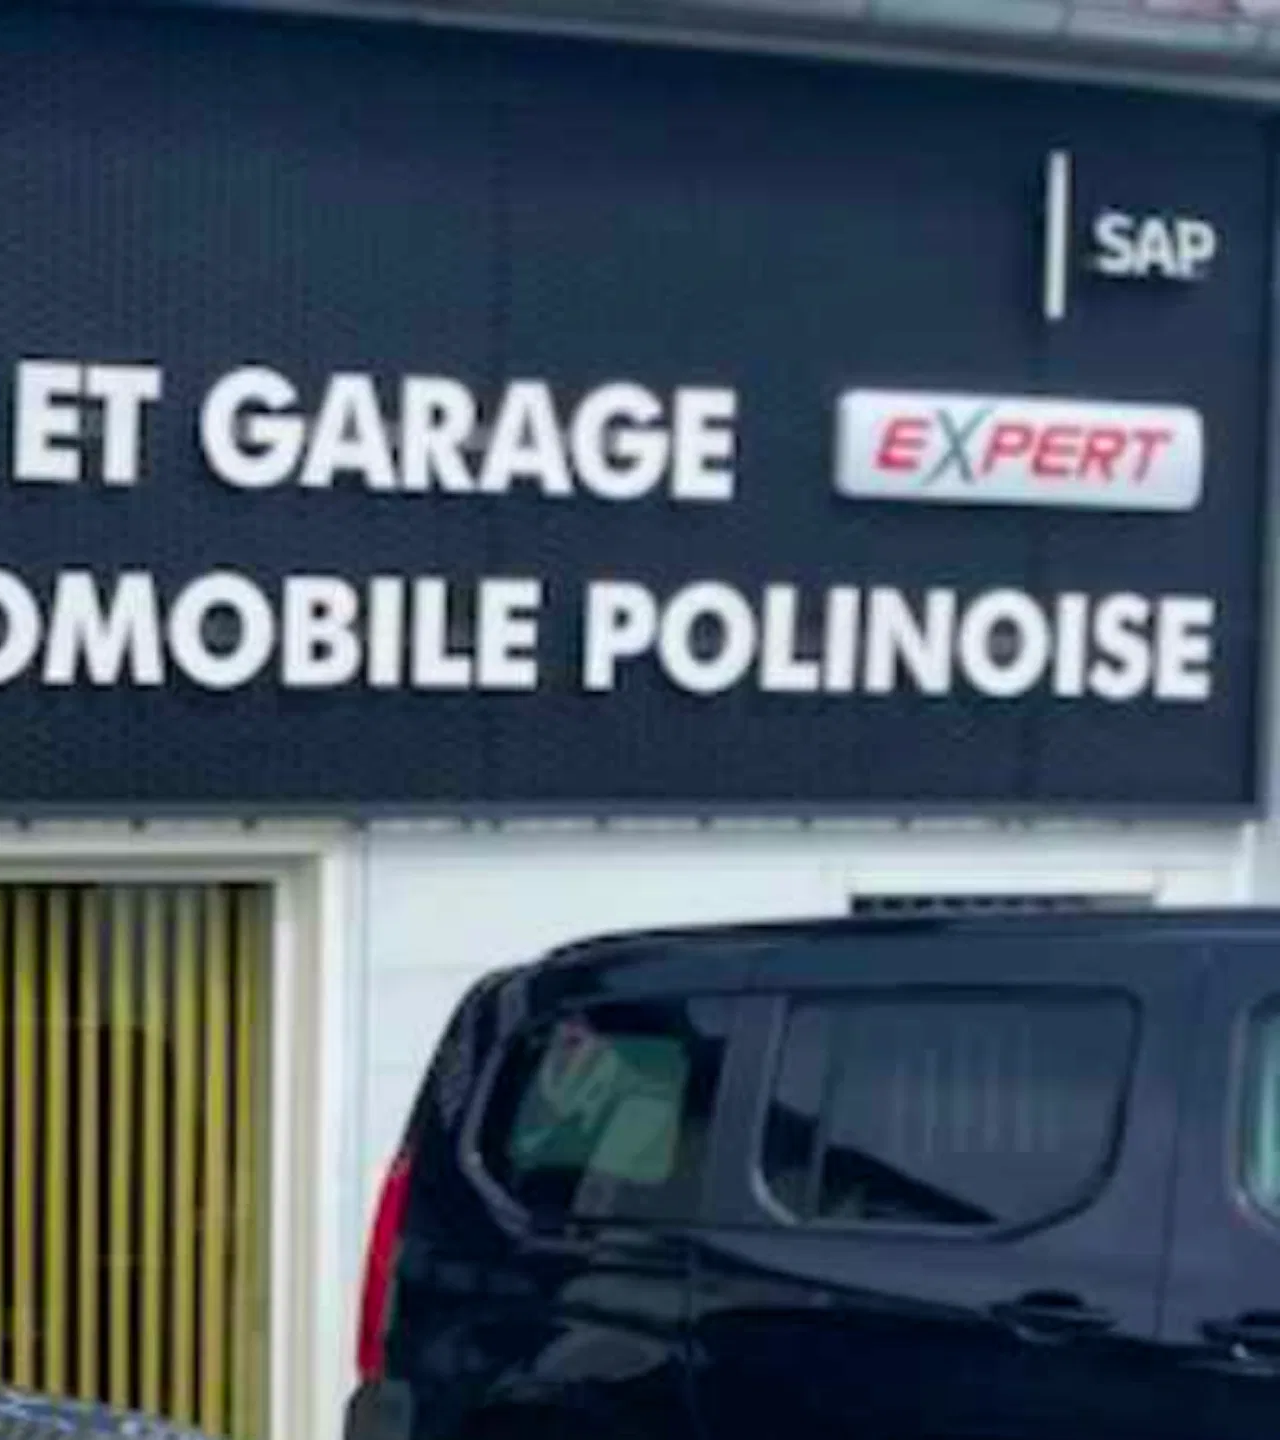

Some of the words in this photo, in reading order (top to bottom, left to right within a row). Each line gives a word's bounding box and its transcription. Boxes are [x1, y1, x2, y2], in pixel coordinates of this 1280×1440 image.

[1096, 213, 1216, 277] SAP
[14, 360, 162, 485] ET
[200, 366, 737, 501] GARAGE
[874, 408, 1174, 486] EXPERT
[584, 580, 1215, 700] POLINOISE
